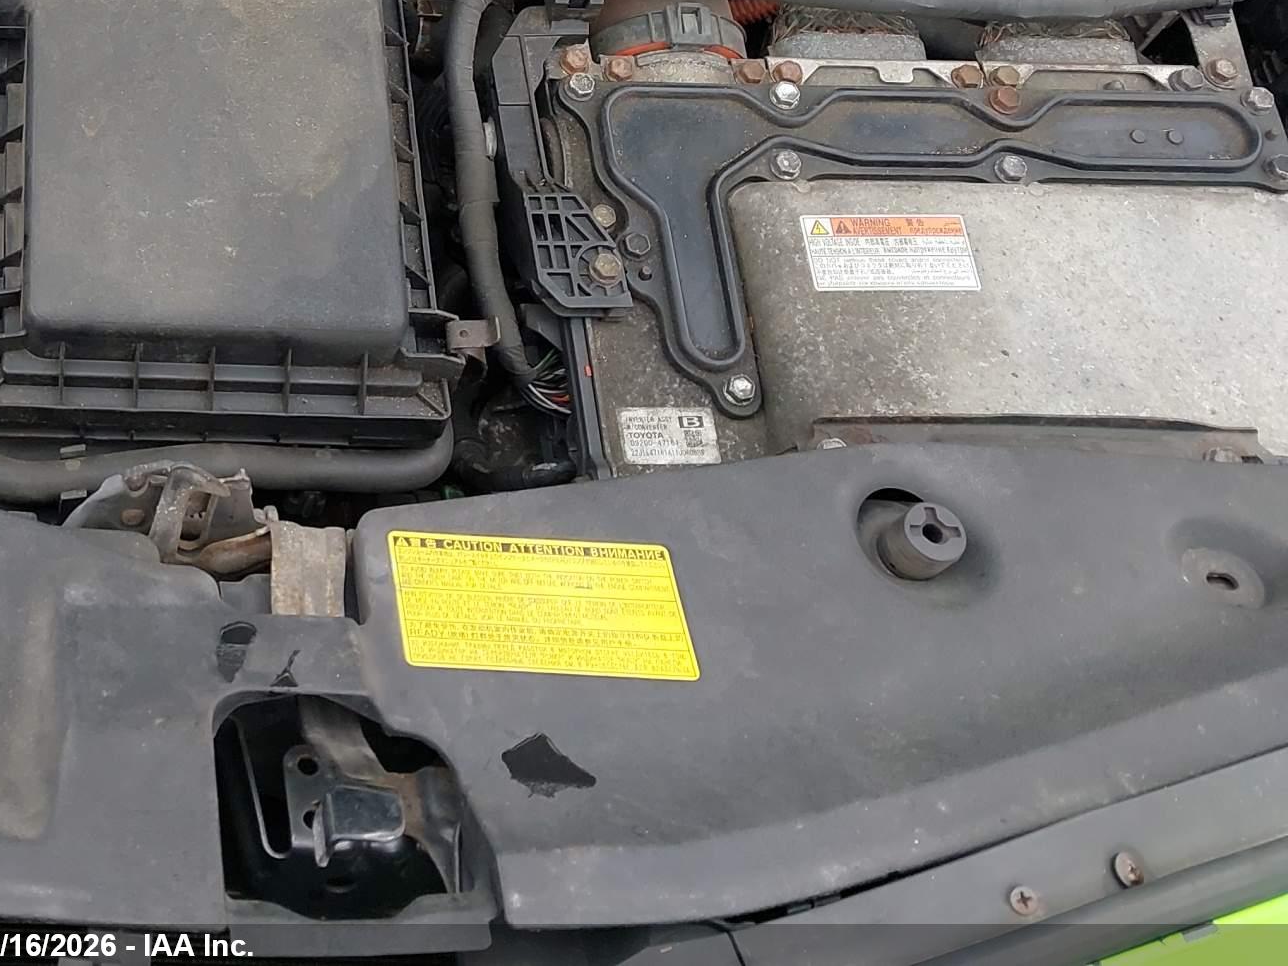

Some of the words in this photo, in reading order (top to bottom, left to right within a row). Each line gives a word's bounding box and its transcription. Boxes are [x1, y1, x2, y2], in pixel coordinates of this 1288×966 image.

[851, 218, 891, 226] WARNING
[443, 540, 503, 552] CAUTION
[510, 543, 585, 556] ATTENTION
[590, 547, 665, 561] ВНИМАНИЕ
